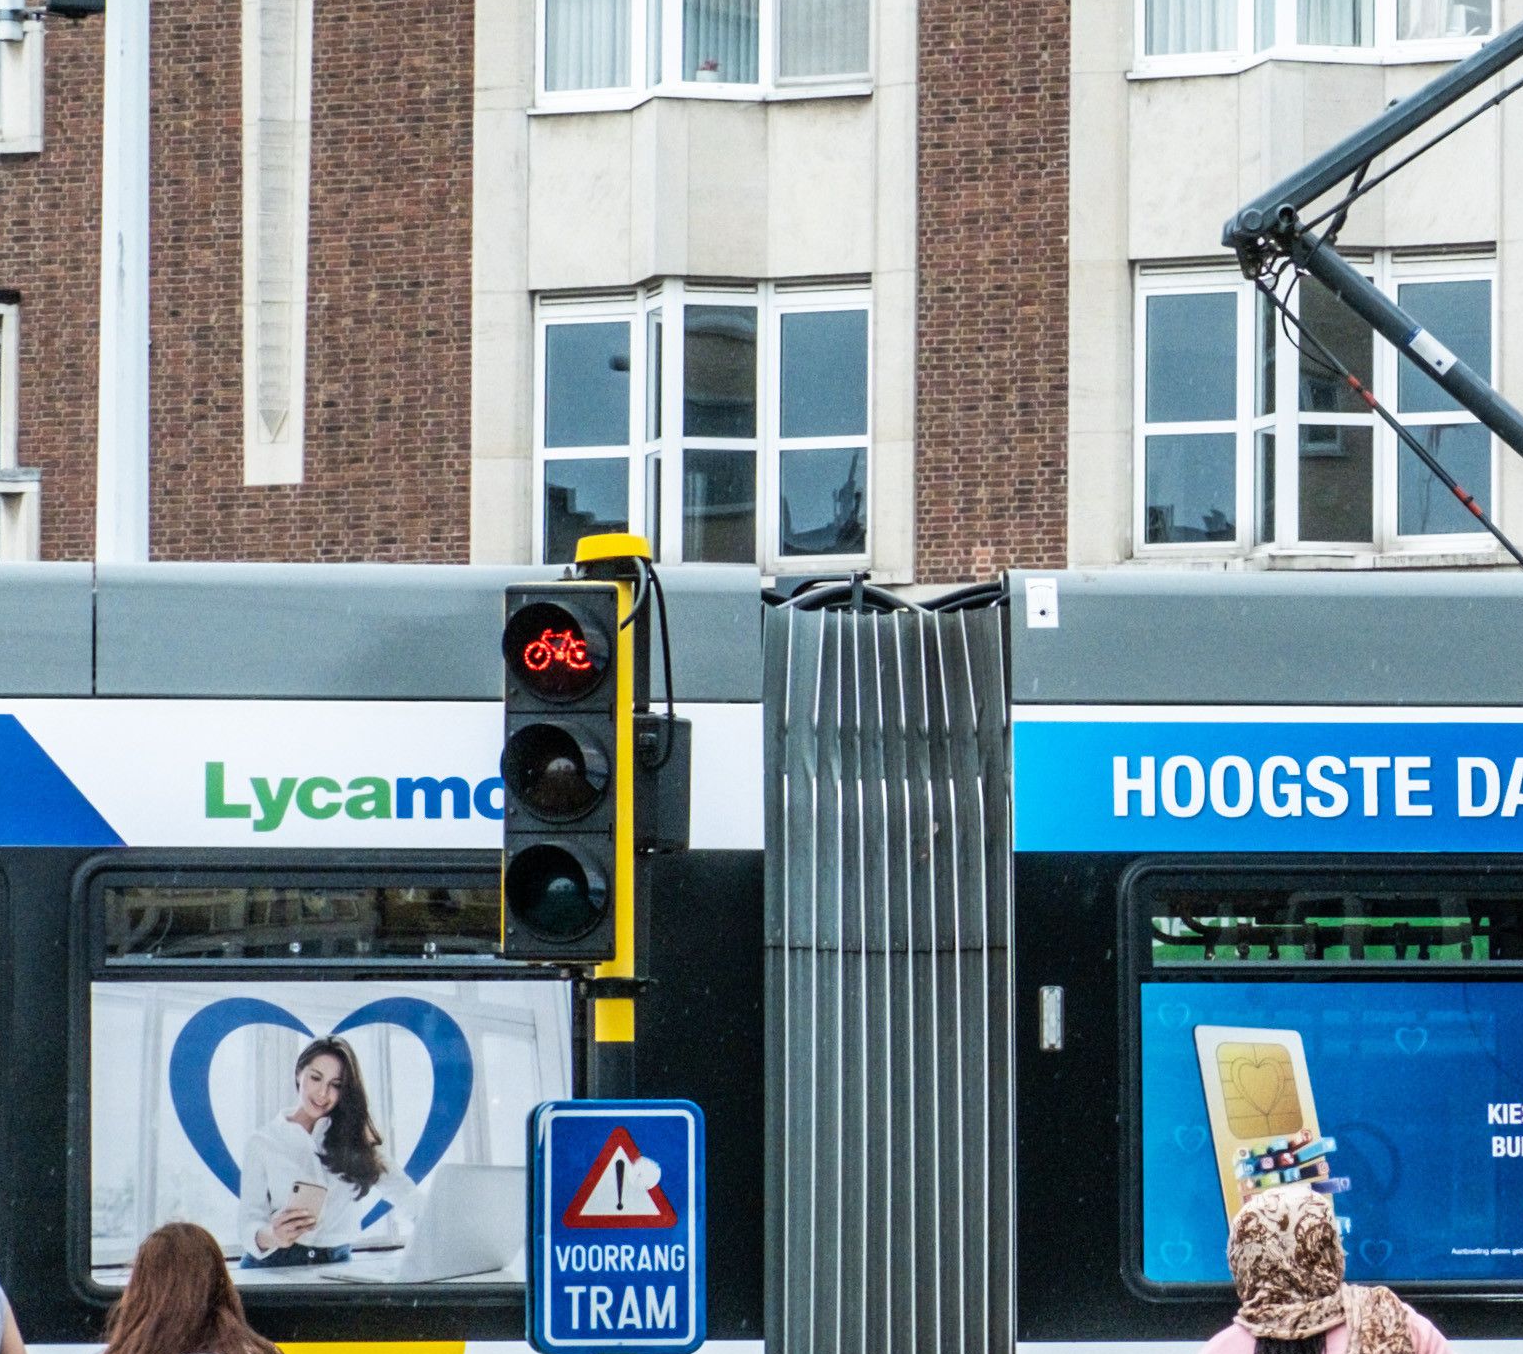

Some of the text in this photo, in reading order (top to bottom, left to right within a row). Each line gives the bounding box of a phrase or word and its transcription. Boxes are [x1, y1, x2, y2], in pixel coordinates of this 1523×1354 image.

[203, 761, 505, 833] Lycamo
[1111, 755, 1434, 820] HOOGSTE
[555, 1243, 686, 1273] VOORRANG
[563, 1284, 677, 1330] TRAM
